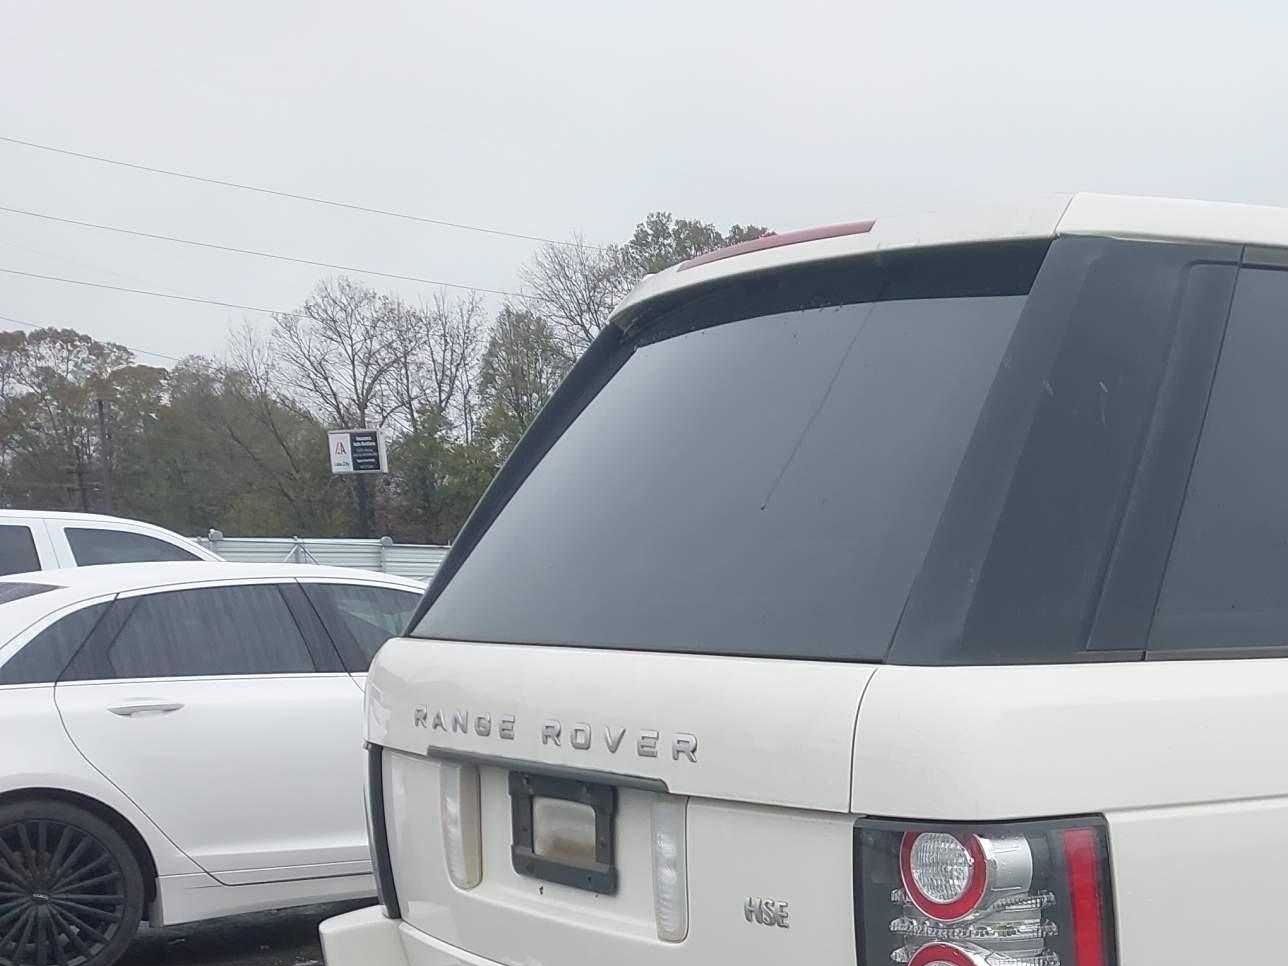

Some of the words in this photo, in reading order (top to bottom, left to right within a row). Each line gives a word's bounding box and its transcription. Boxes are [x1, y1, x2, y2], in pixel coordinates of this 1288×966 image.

[414, 703, 516, 740] RANGE
[541, 718, 698, 763] ROVER
[744, 896, 789, 928] HSE
